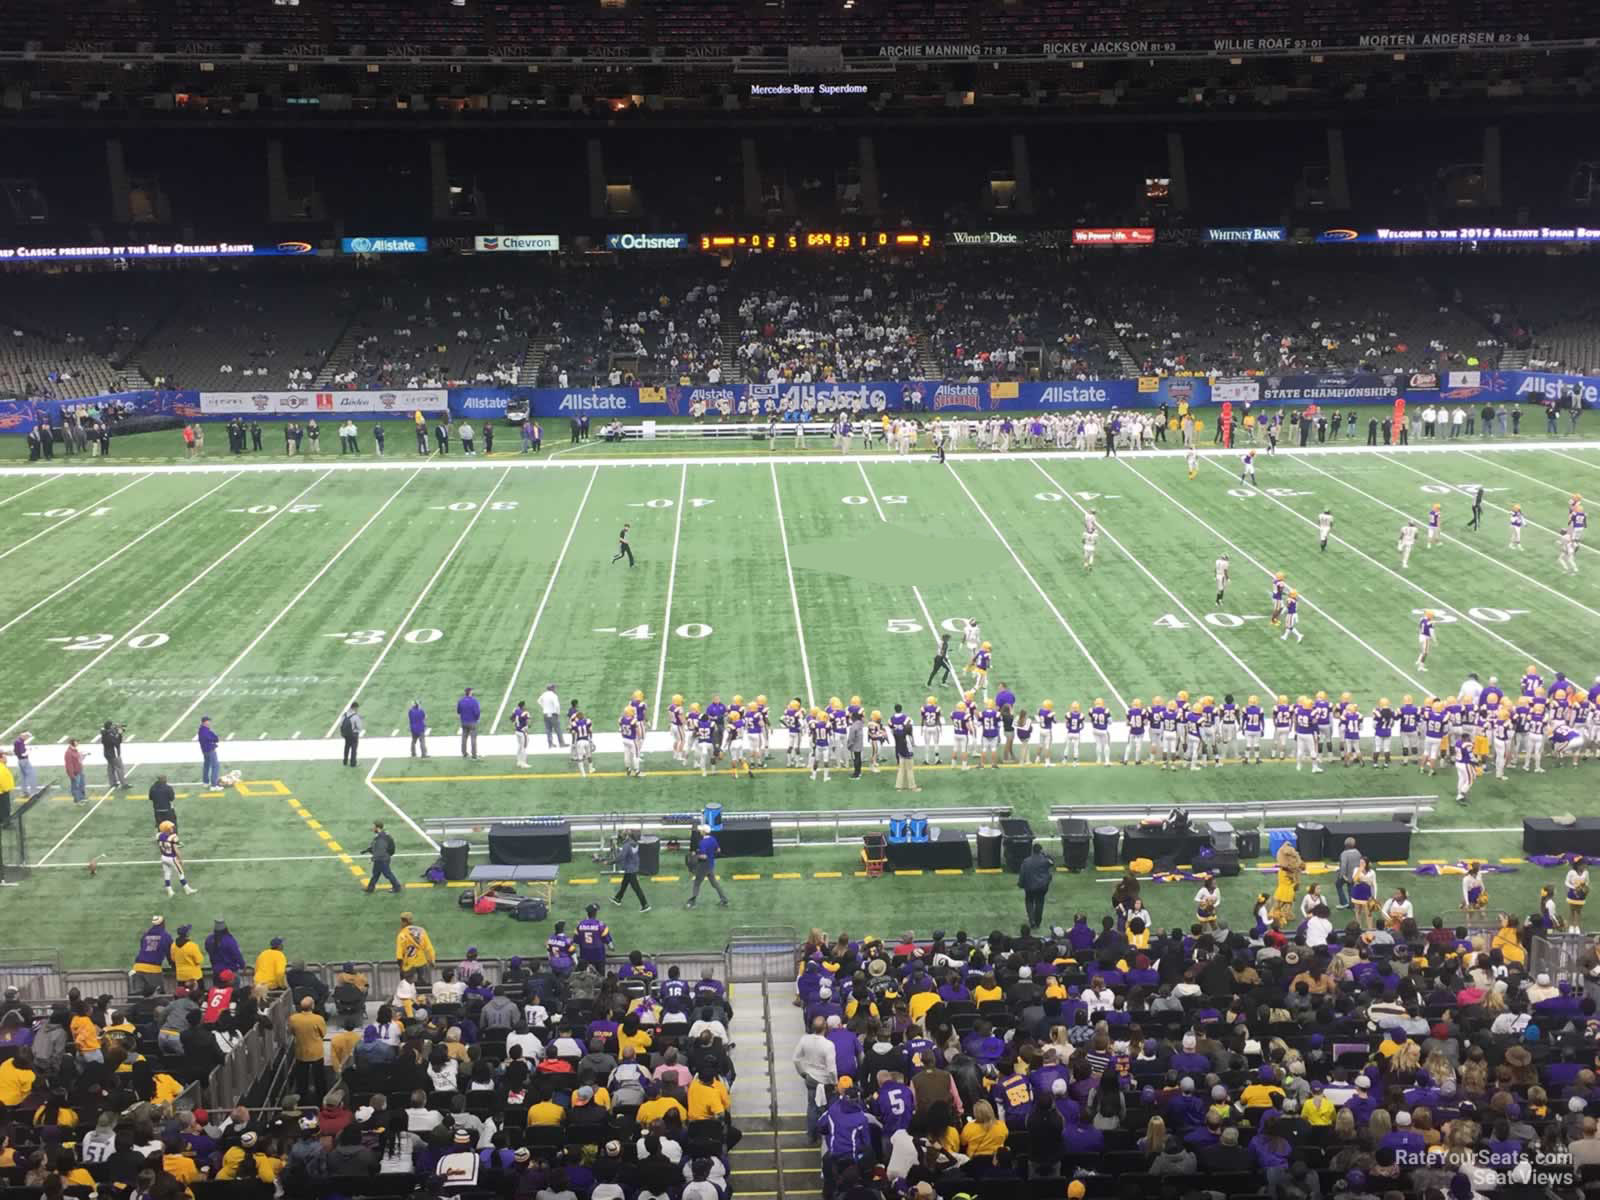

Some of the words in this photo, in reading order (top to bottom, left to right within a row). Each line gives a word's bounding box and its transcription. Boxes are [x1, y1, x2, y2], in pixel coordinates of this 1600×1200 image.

[1214, 39, 1254, 50] WILLIE
[1258, 38, 1292, 49] ROAF
[1359, 34, 1415, 47] MORTEN
[1422, 32, 1494, 46] ANDERSEN
[879, 45, 921, 57] ARCHIE
[925, 44, 980, 56] MANNING
[1043, 42, 1086, 54] RICKEY
[1090, 41, 1149, 54] JACKSON
[751, 84, 815, 96] Mercedes-Benz
[818, 84, 868, 96] Superdome
[953, 232, 980, 243] Winn
[989, 232, 1017, 243] Dixie
[1208, 228, 1253, 241] WHITNEY
[1253, 228, 1281, 241] BANK
[1460, 227, 1491, 239] 2016
[372, 238, 416, 251] Allstate
[502, 236, 551, 249] Chevron
[621, 234, 681, 249] Ochsner
[147, 244, 171, 254] NEW
[174, 243, 217, 254] ORLEANS
[220, 243, 254, 253] SAINTS
[689, 388, 734, 400] Allstate
[754, 385, 775, 395] CST
[936, 384, 979, 396] Allstate
[1039, 386, 1107, 403] Allstate
[1264, 389, 1301, 399] STATE
[1303, 387, 1398, 399] CHAMPIONSHIPS
[463, 397, 508, 409] Allstate
[558, 393, 628, 410] Allstate
[1153, 612, 1245, 629] 40
[618, 622, 714, 640] 40
[584, 932, 593, 945] 5
[406, 945, 417, 958] 2
[210, 994, 223, 1008] 6
[888, 1088, 906, 1115] 5
[86, 1145, 106, 1162] 51
